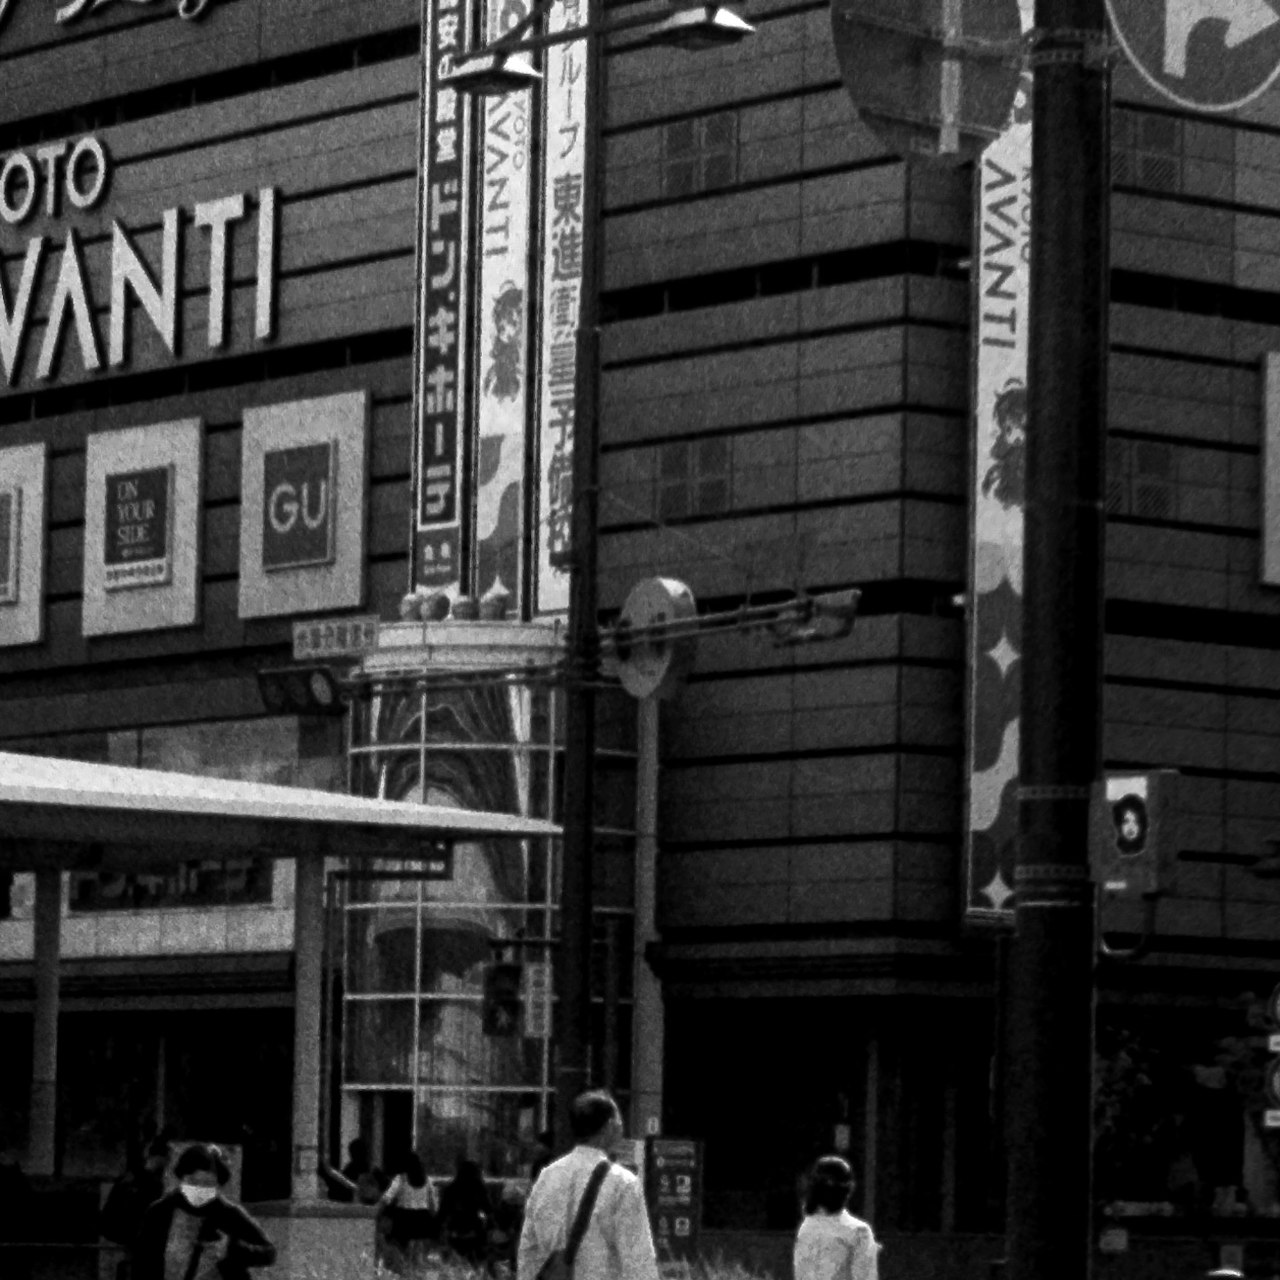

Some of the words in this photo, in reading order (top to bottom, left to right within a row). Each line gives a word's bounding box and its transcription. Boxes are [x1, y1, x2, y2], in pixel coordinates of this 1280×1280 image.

[435, 0, 460, 163] 安の殿堂
[982, 158, 1019, 348] AVANTI
[116, 480, 139, 501] ON
[267, 478, 328, 534] GU
[116, 499, 156, 524] YOUR
[116, 523, 150, 546] SIDE
